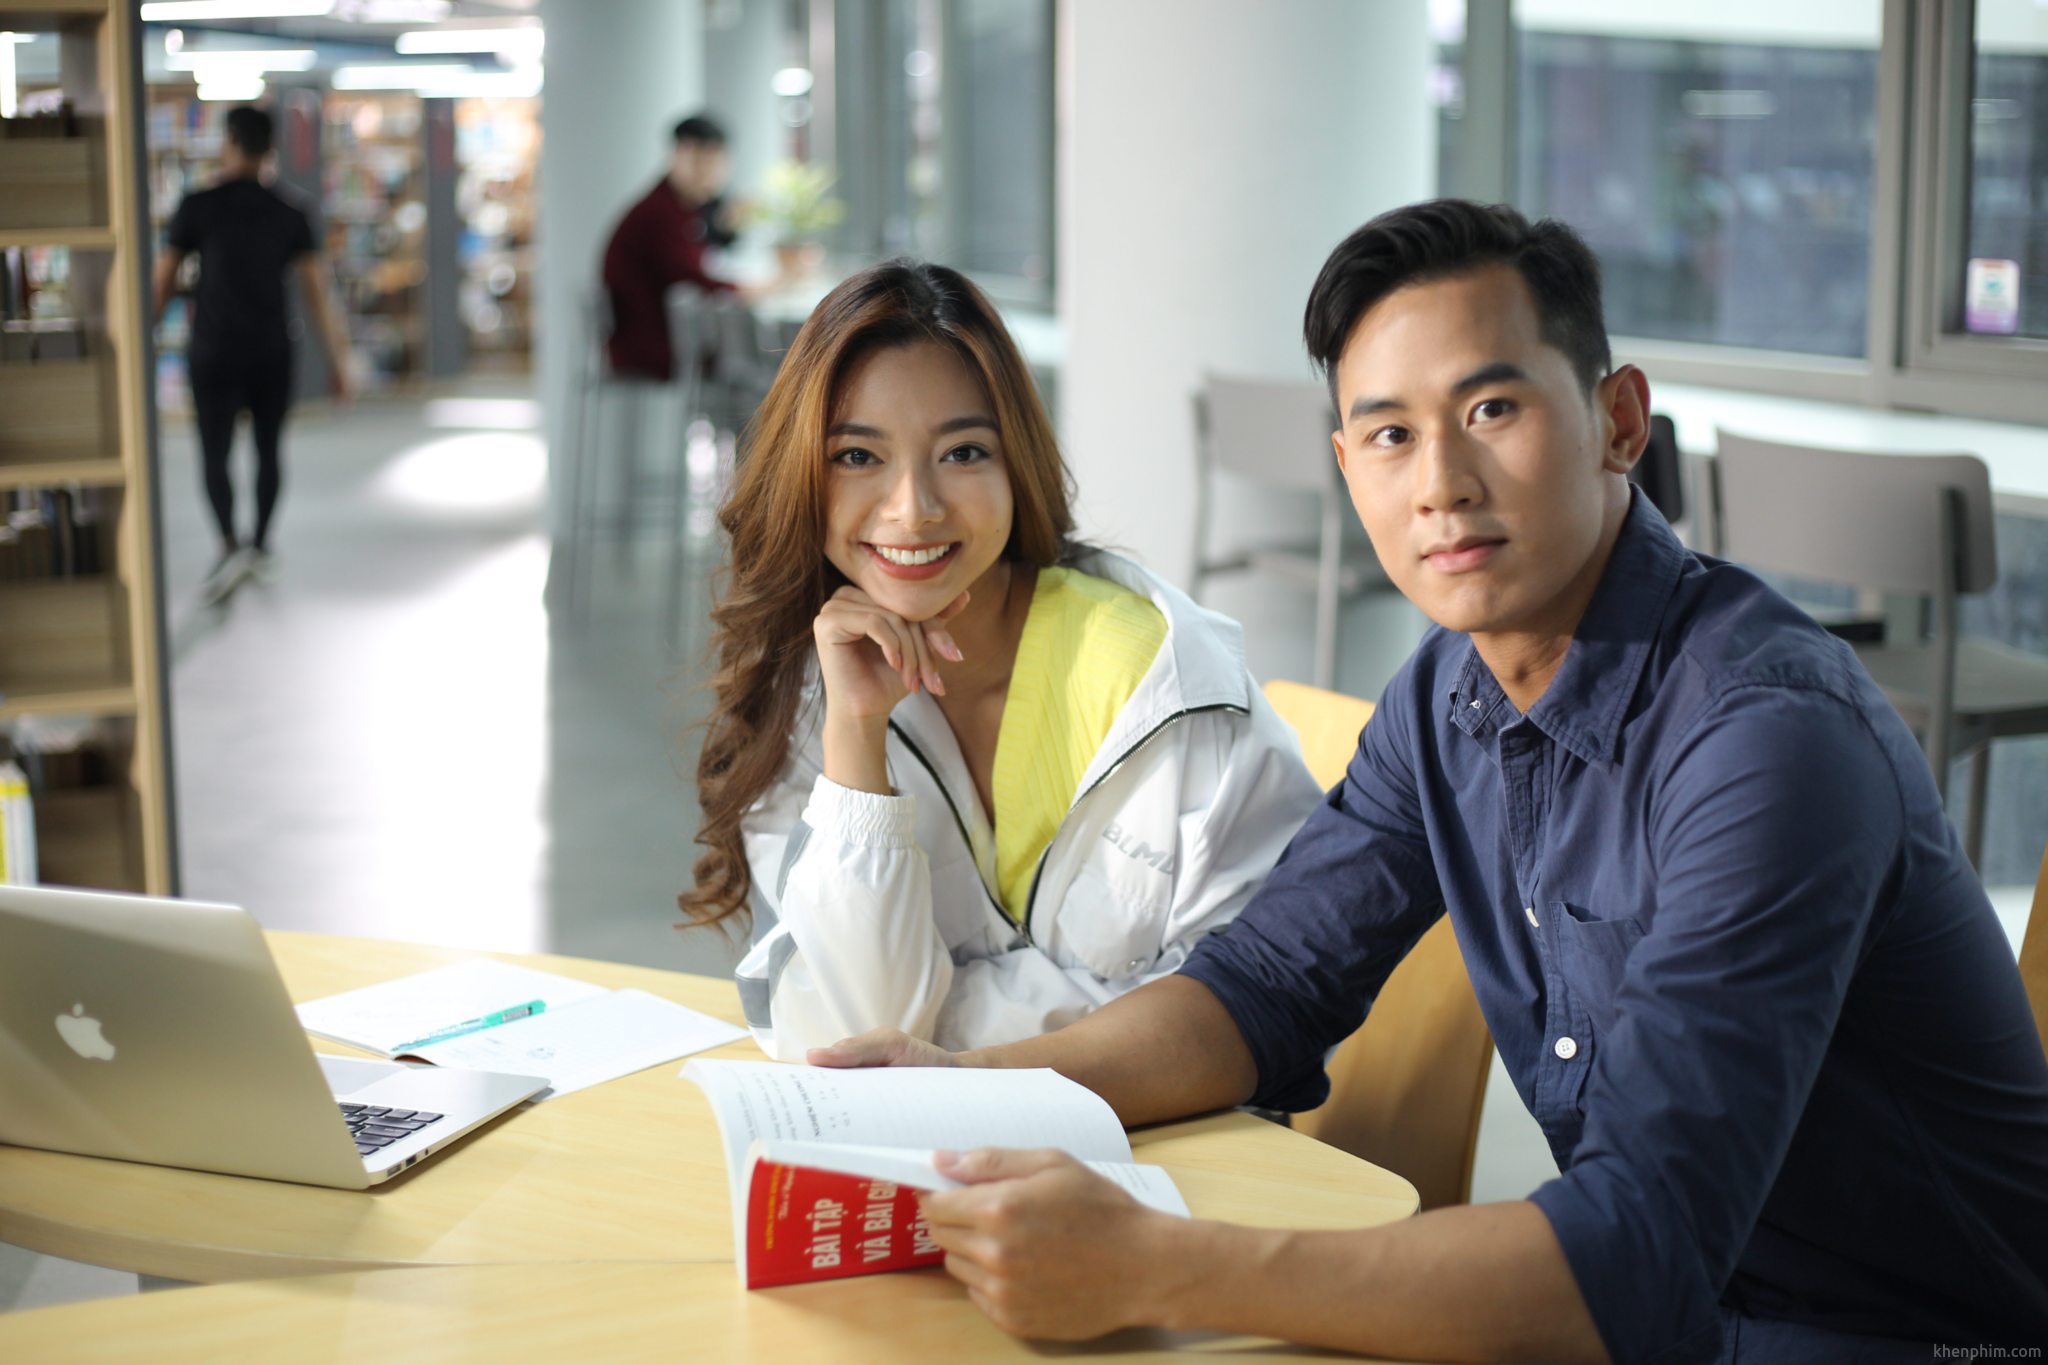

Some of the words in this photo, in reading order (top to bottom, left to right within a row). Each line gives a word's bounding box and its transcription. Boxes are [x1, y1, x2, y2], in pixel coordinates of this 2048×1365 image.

[805, 1198, 849, 1233] TẬP
[857, 1202, 894, 1232] BÀI
[804, 1233, 841, 1270] BÀI
[855, 1235, 892, 1263] VÀ
